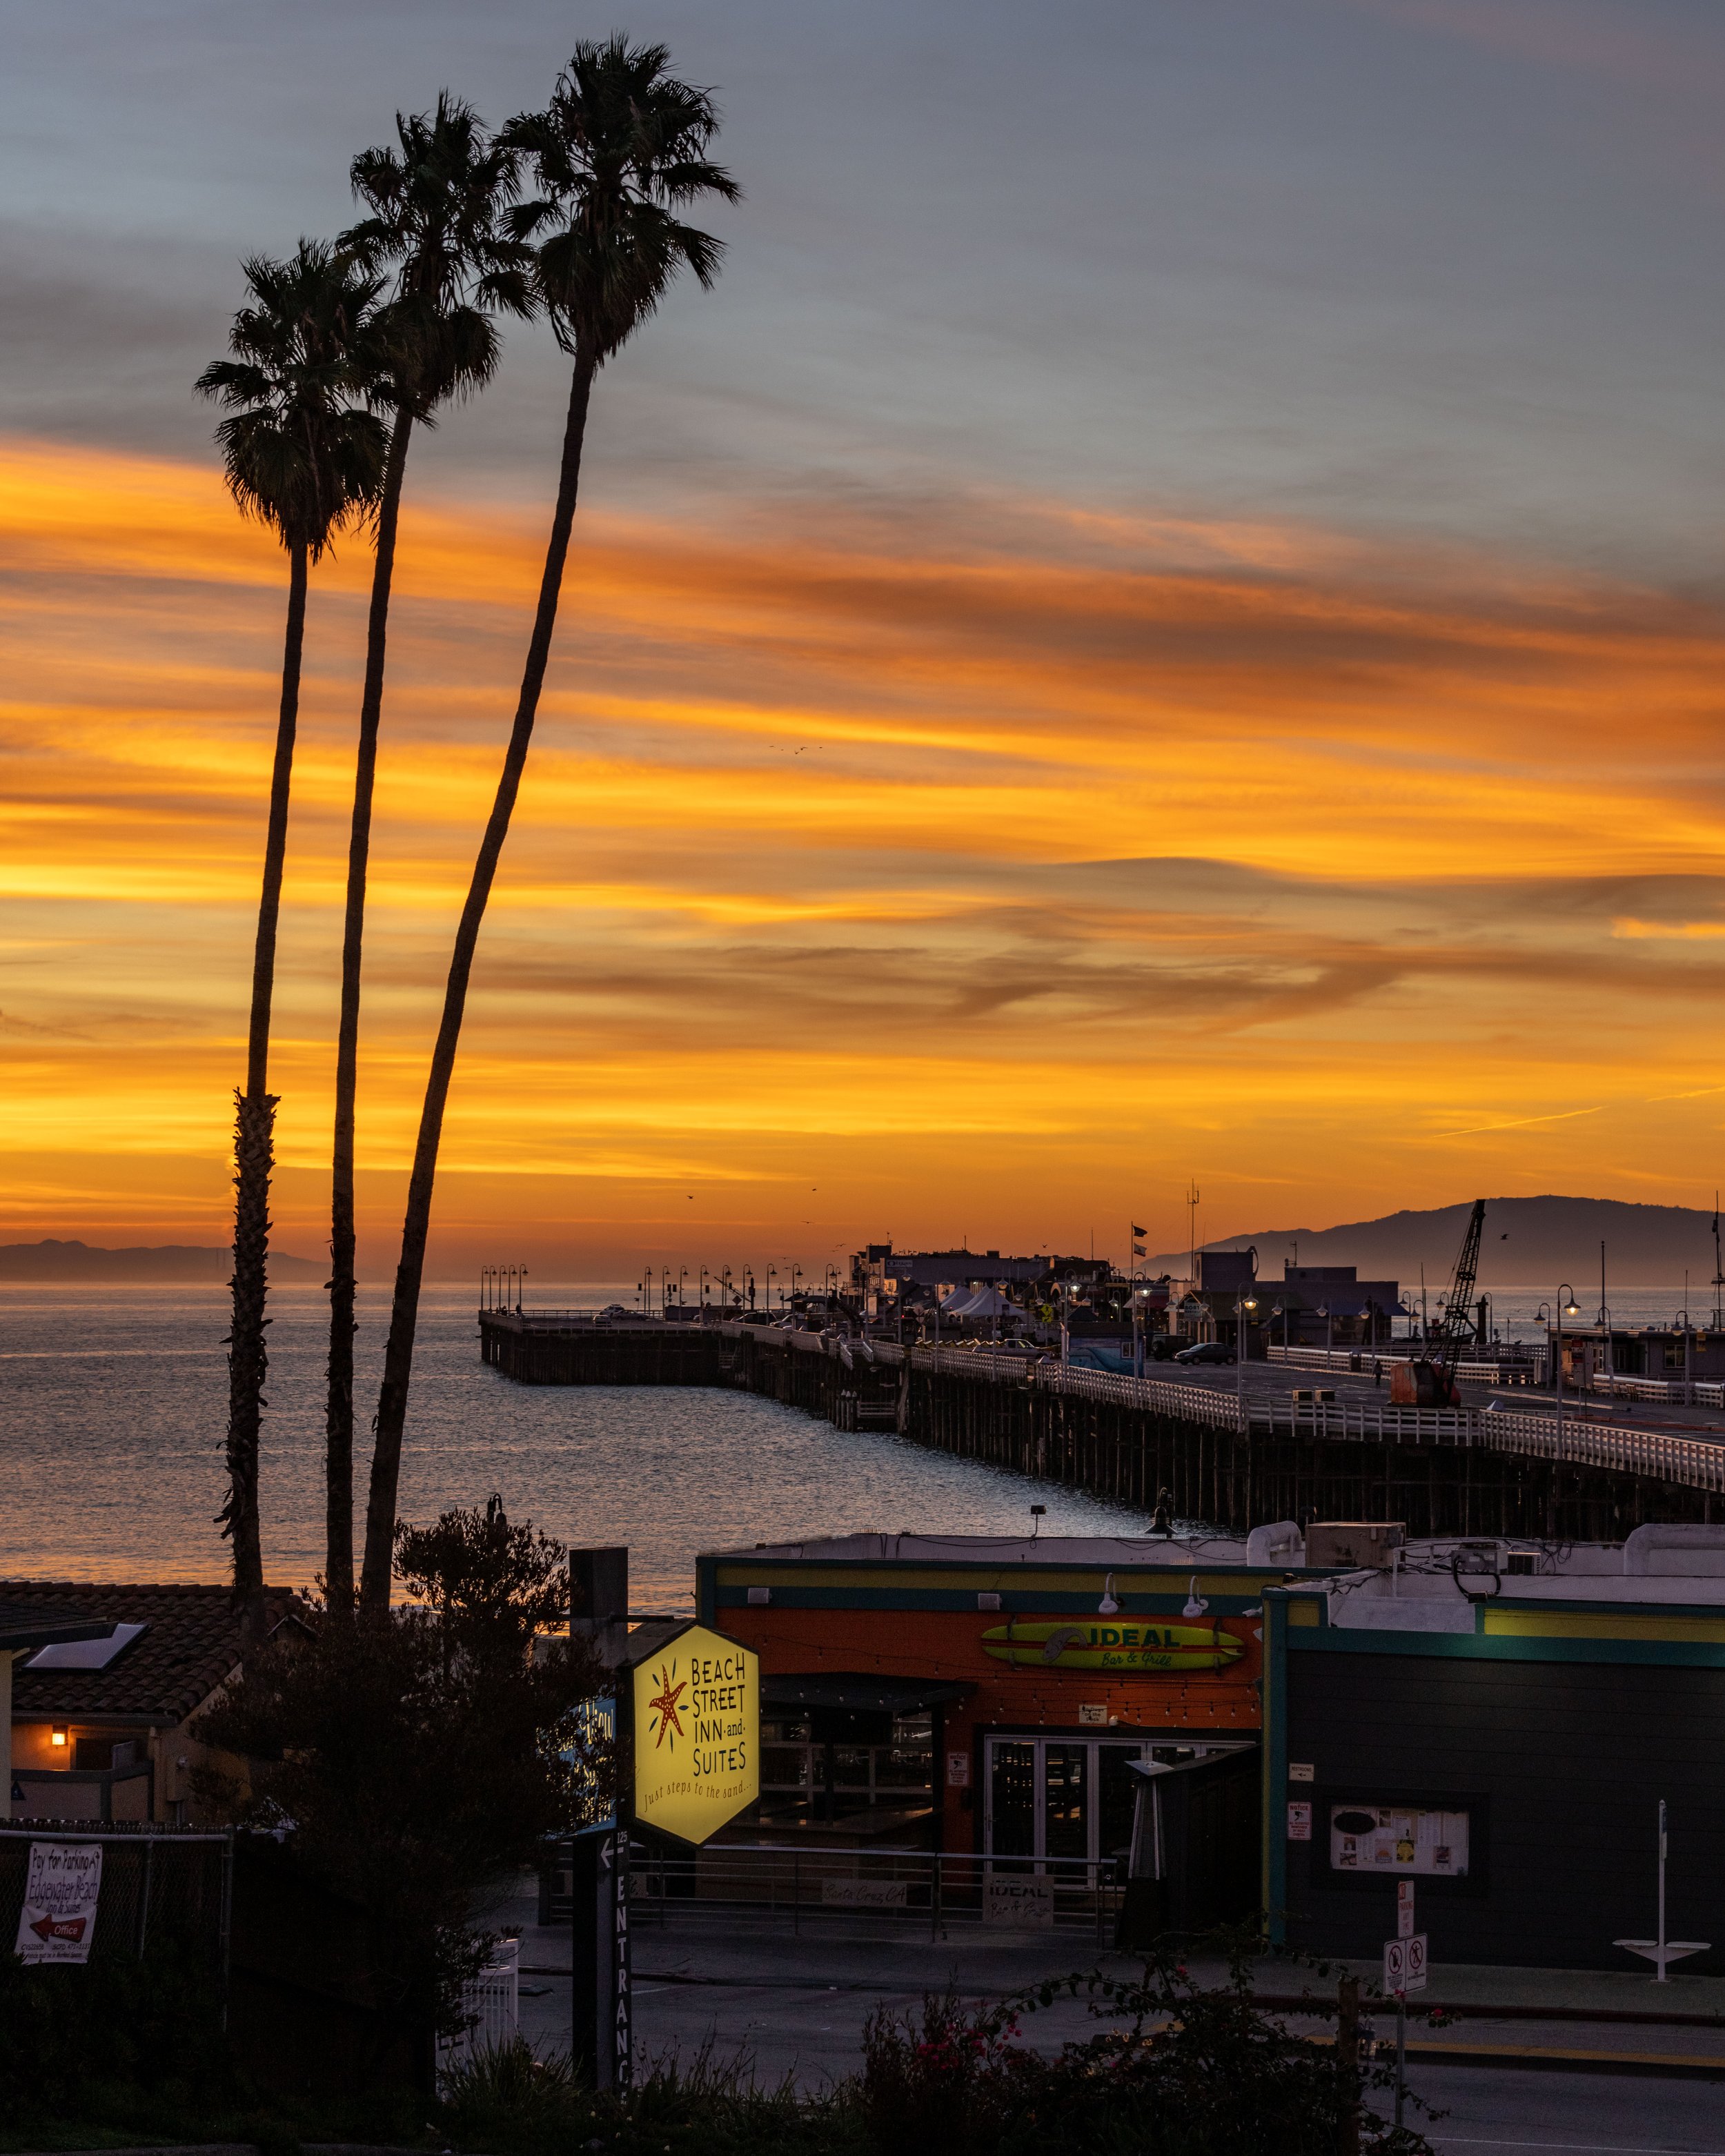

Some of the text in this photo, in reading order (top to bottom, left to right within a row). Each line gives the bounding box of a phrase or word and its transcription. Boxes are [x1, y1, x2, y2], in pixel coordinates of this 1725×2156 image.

[1091, 1628, 1181, 1648] IDEAL
[1101, 1650, 1172, 1667] Bar & Grill
[692, 1652, 745, 1686] BEACH
[692, 1684, 745, 1719] STREET
[695, 1719, 723, 1743] INN
[693, 1741, 746, 1777] SUITES
[667, 1781, 691, 1795] steps
[695, 1782, 703, 1795] to
[707, 1785, 720, 1799] the
[617, 1830, 628, 1843] 125
[32, 1848, 100, 1876] Pay for Parking At
[29, 1870, 98, 1908] Edgewater Beach
[823, 1883, 854, 1900] Santa
[886, 1887, 906, 1901] CA
[990, 1881, 1048, 1897] IDEAL
[46, 1900, 57, 1914] Inn
[58, 1901, 64, 1915] &
[55, 1925, 78, 1935] Office
